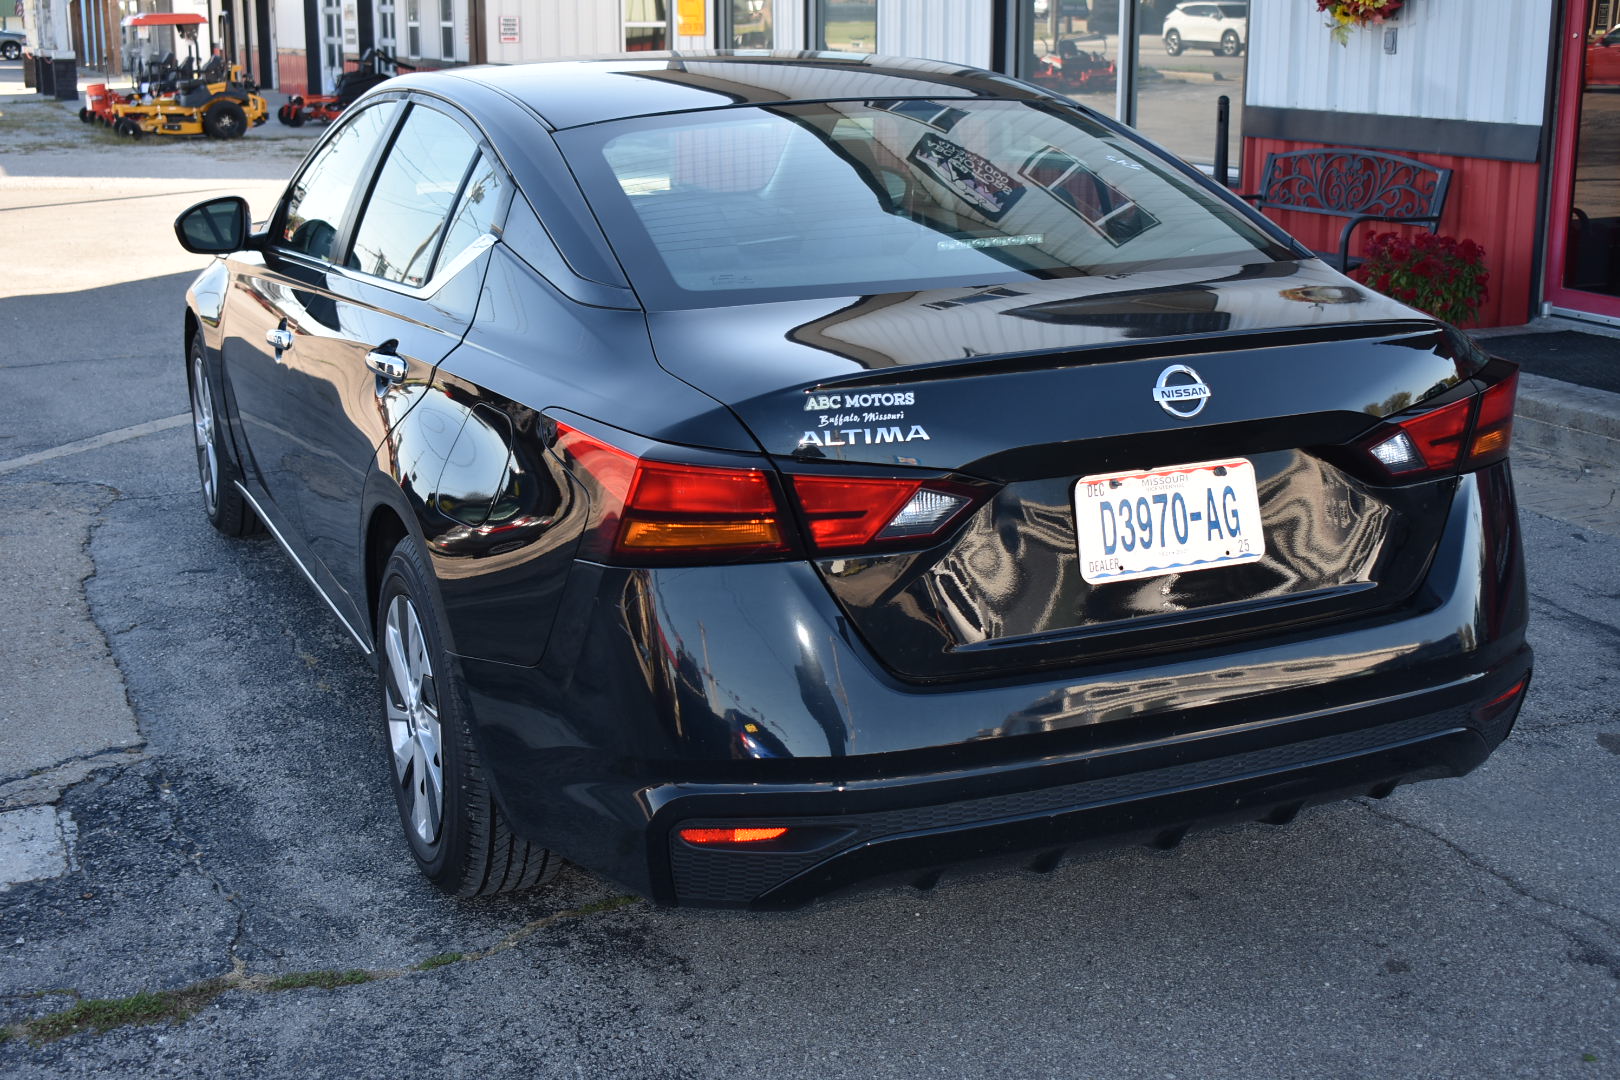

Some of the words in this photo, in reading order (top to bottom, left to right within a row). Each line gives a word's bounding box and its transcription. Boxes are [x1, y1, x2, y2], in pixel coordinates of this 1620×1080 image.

[1161, 387, 1207, 398] NISSAN
[804, 395, 841, 411] ABC
[845, 391, 915, 408] MOTORS
[818, 414, 860, 428] Buffalo,
[862, 411, 904, 423] Missouri
[798, 425, 931, 447] ALTIMA
[1141, 474, 1189, 487] MISSOURI
[1087, 483, 1105, 498] DEC
[1100, 485, 1241, 556] D3970-AG
[1239, 538, 1250, 553] 25
[1089, 557, 1120, 573] DEALER
